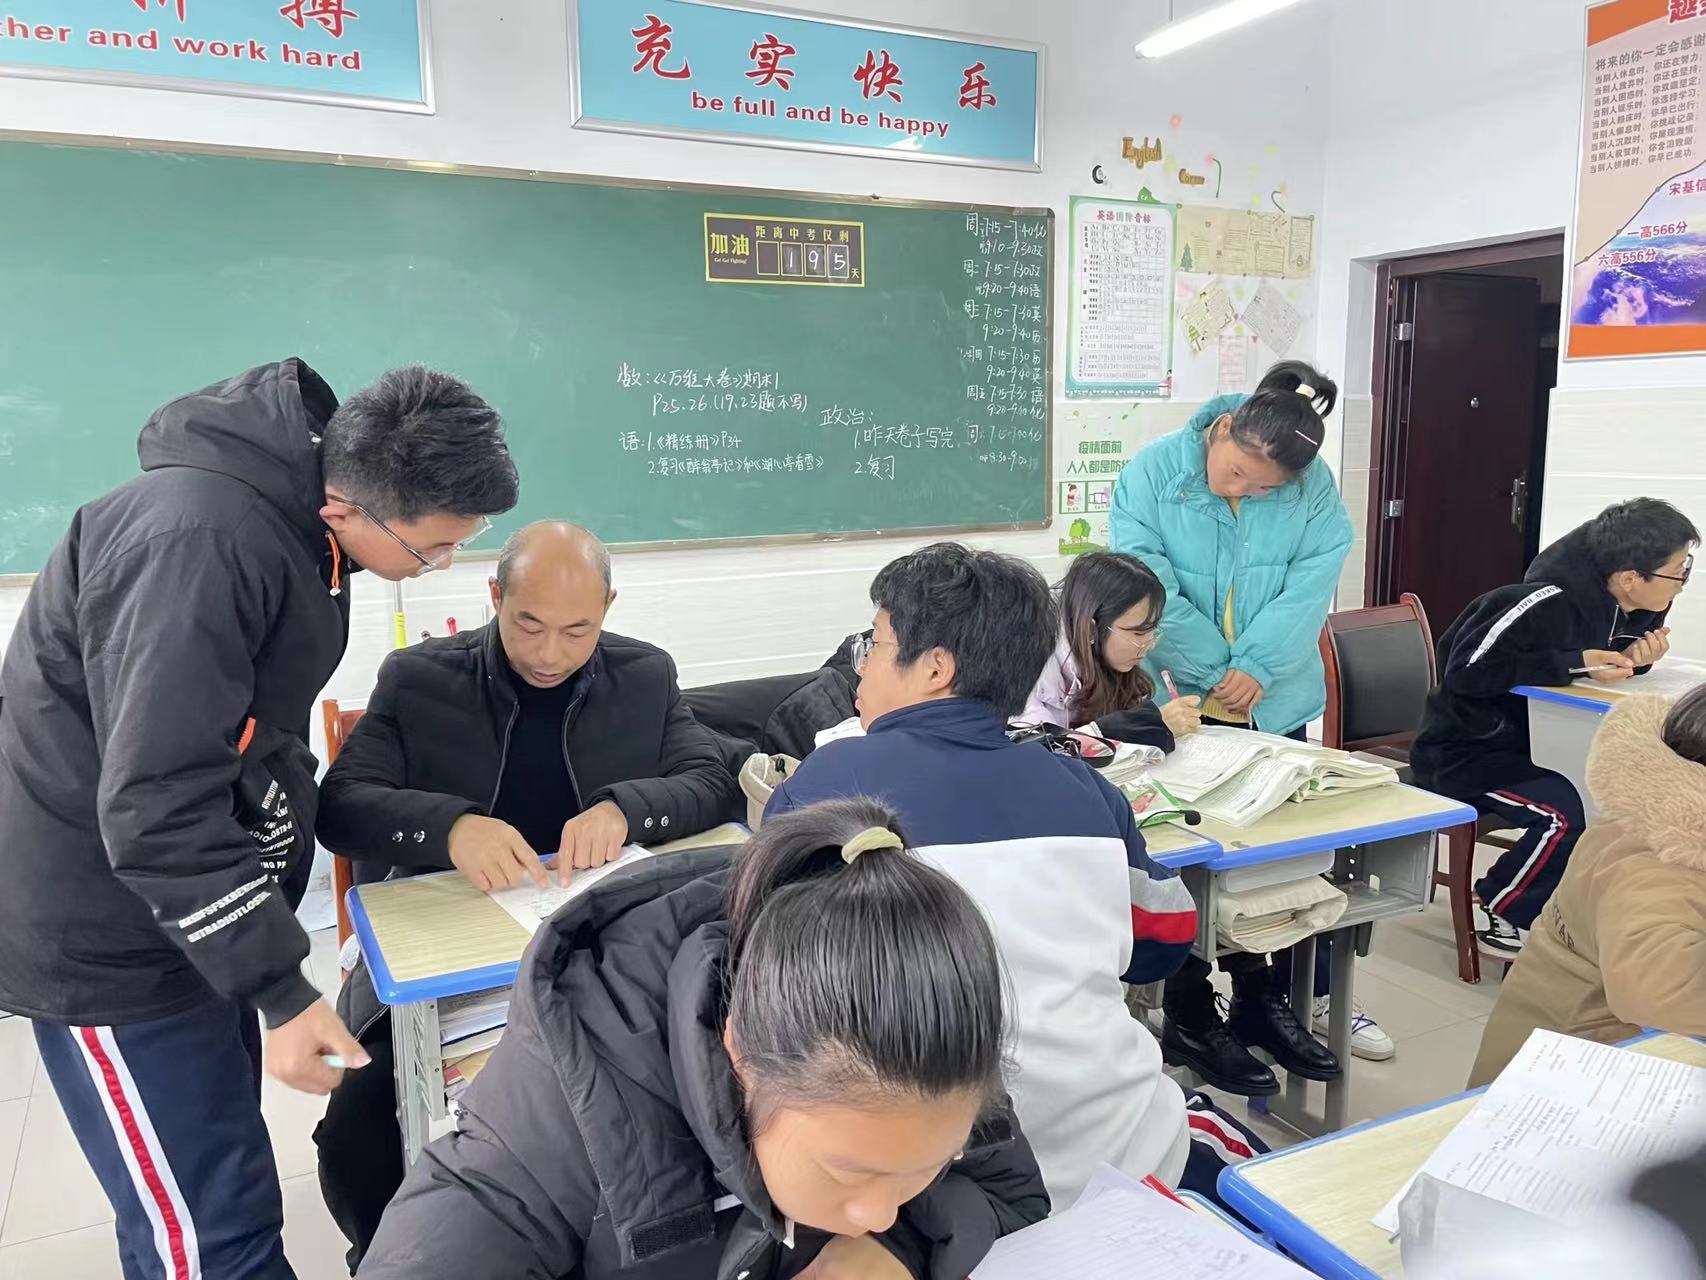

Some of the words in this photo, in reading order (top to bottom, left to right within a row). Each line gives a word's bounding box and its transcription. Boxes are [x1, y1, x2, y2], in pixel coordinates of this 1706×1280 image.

[0, 16, 72, 42] her
[89, 30, 158, 50] and
[174, 37, 269, 61] work
[282, 44, 361, 70] hard
[630, 14, 998, 111] 充实快乐
[691, 91, 724, 111] be
[733, 95, 776, 117] full
[786, 103, 831, 123] and
[841, 106, 869, 127] be
[878, 113, 951, 138] happy
[755, 225, 849, 243] 距离中考仅剩
[1628, 221, 1688, 238] 一高566分
[710, 232, 749, 256] 加油
[1598, 249, 1656, 266] 六高556分
[851, 268, 860, 279] 天
[1078, 440, 1122, 454] 疫情面前
